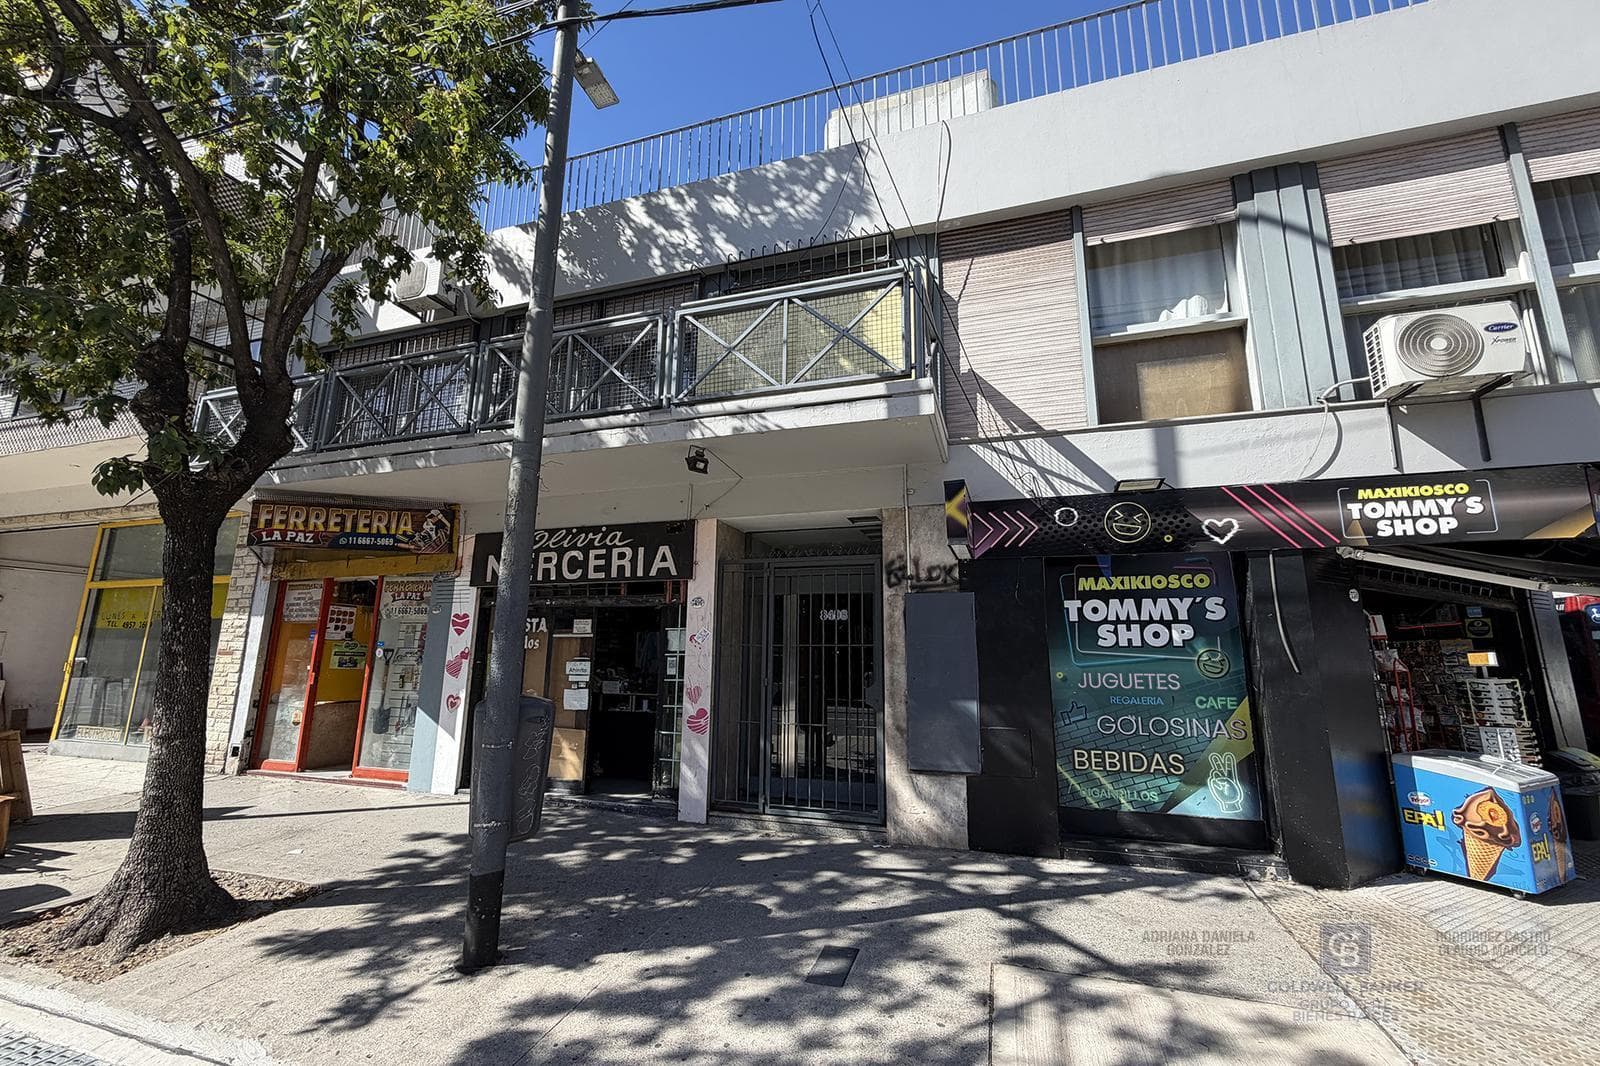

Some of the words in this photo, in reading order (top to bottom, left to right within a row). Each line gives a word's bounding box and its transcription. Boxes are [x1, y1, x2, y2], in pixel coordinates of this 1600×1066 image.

[1488, 323, 1514, 331] Carrier
[1357, 482, 1470, 500] MAXIKIOSCO
[1346, 496, 1484, 520] TOMMY'S
[257, 504, 415, 535] FERRETERIA
[1376, 517, 1459, 537] SHOP
[262, 531, 282, 542] LA
[285, 531, 314, 544] PAZ
[1077, 573, 1211, 591] MAXIKIOSCO
[395, 592, 405, 600] LA
[406, 592, 422, 600] PAZ
[1064, 596, 1227, 622] TOMMY'S
[524, 635, 540, 649] los
[1096, 623, 1195, 648] SHOP
[1078, 672, 1181, 690] JUGUETES
[1109, 696, 1165, 705] REGALERIA
[1195, 696, 1238, 710] CAFE
[1096, 714, 1248, 740] GOLOSINAS
[1073, 749, 1186, 775] BEBIDAS
[1403, 809, 1446, 831] EPA!
[1532, 833, 1551, 863] EPA!
